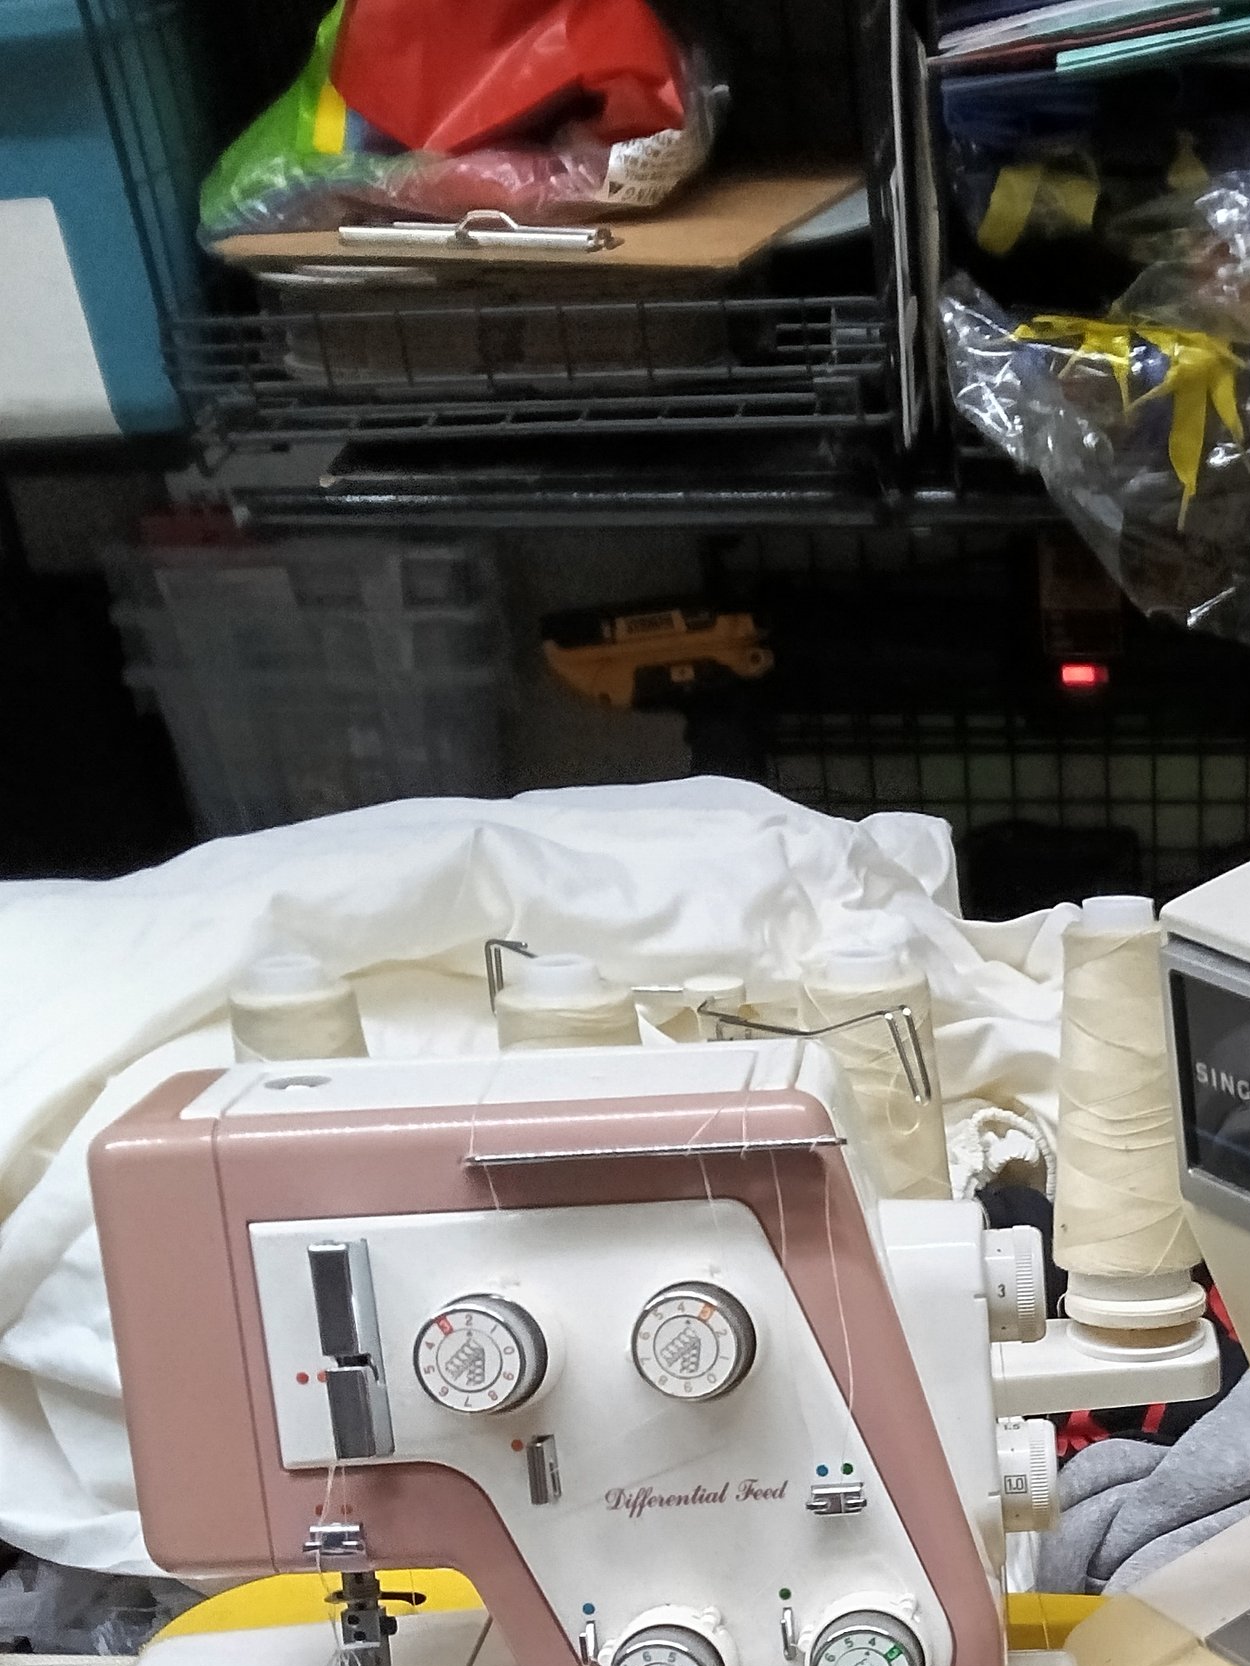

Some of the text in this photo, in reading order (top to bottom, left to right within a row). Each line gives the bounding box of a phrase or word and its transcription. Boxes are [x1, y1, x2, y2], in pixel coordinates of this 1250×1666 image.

[997, 1283, 1006, 1299] 3
[677, 1301, 685, 1313] 4
[465, 1313, 474, 1327] 2
[424, 1340, 436, 1351] 4
[422, 1364, 436, 1375] 5
[463, 1395, 473, 1409] 7
[1006, 1477, 1025, 1491] 1.0
[604, 1478, 789, 1519] Differential Feed
[843, 1637, 855, 1649] 5
[868, 1637, 876, 1647] 4
[642, 1651, 652, 1662] 6
[667, 1651, 677, 1663] 5
